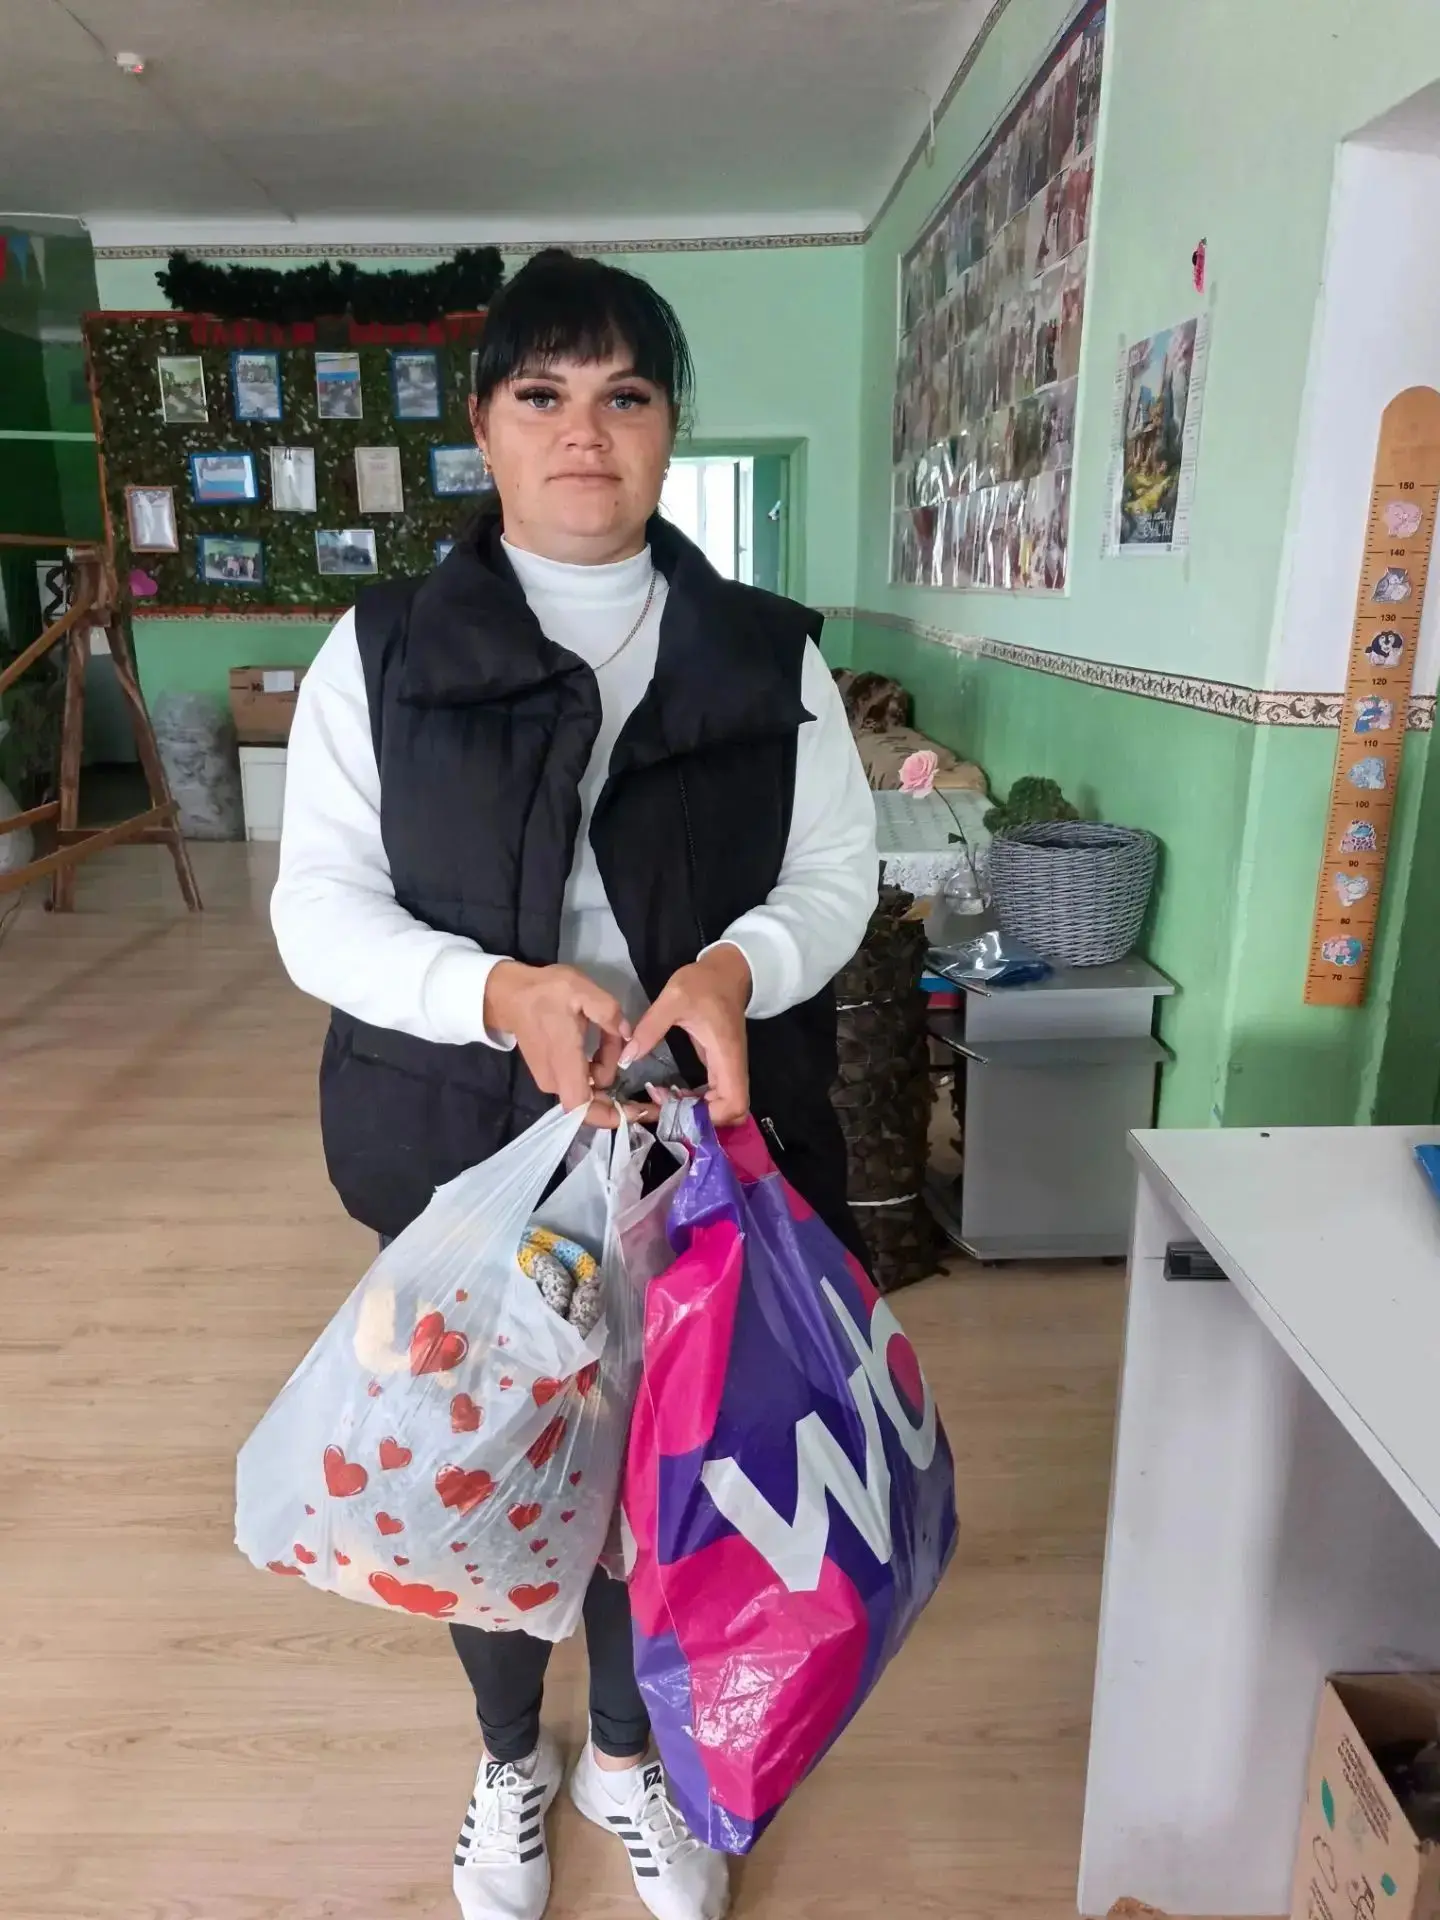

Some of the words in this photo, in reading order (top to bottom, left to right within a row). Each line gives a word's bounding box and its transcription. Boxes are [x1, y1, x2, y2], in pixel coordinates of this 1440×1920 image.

[1399, 481, 1415, 490] 150
[1389, 548, 1405, 557] 140
[1380, 614, 1396, 622] 130
[1372, 678, 1387, 686] 120
[1363, 740, 1378, 748] 110
[1355, 800, 1370, 809] 100
[1348, 860, 1359, 868] 90
[1332, 973, 1342, 981] 70
